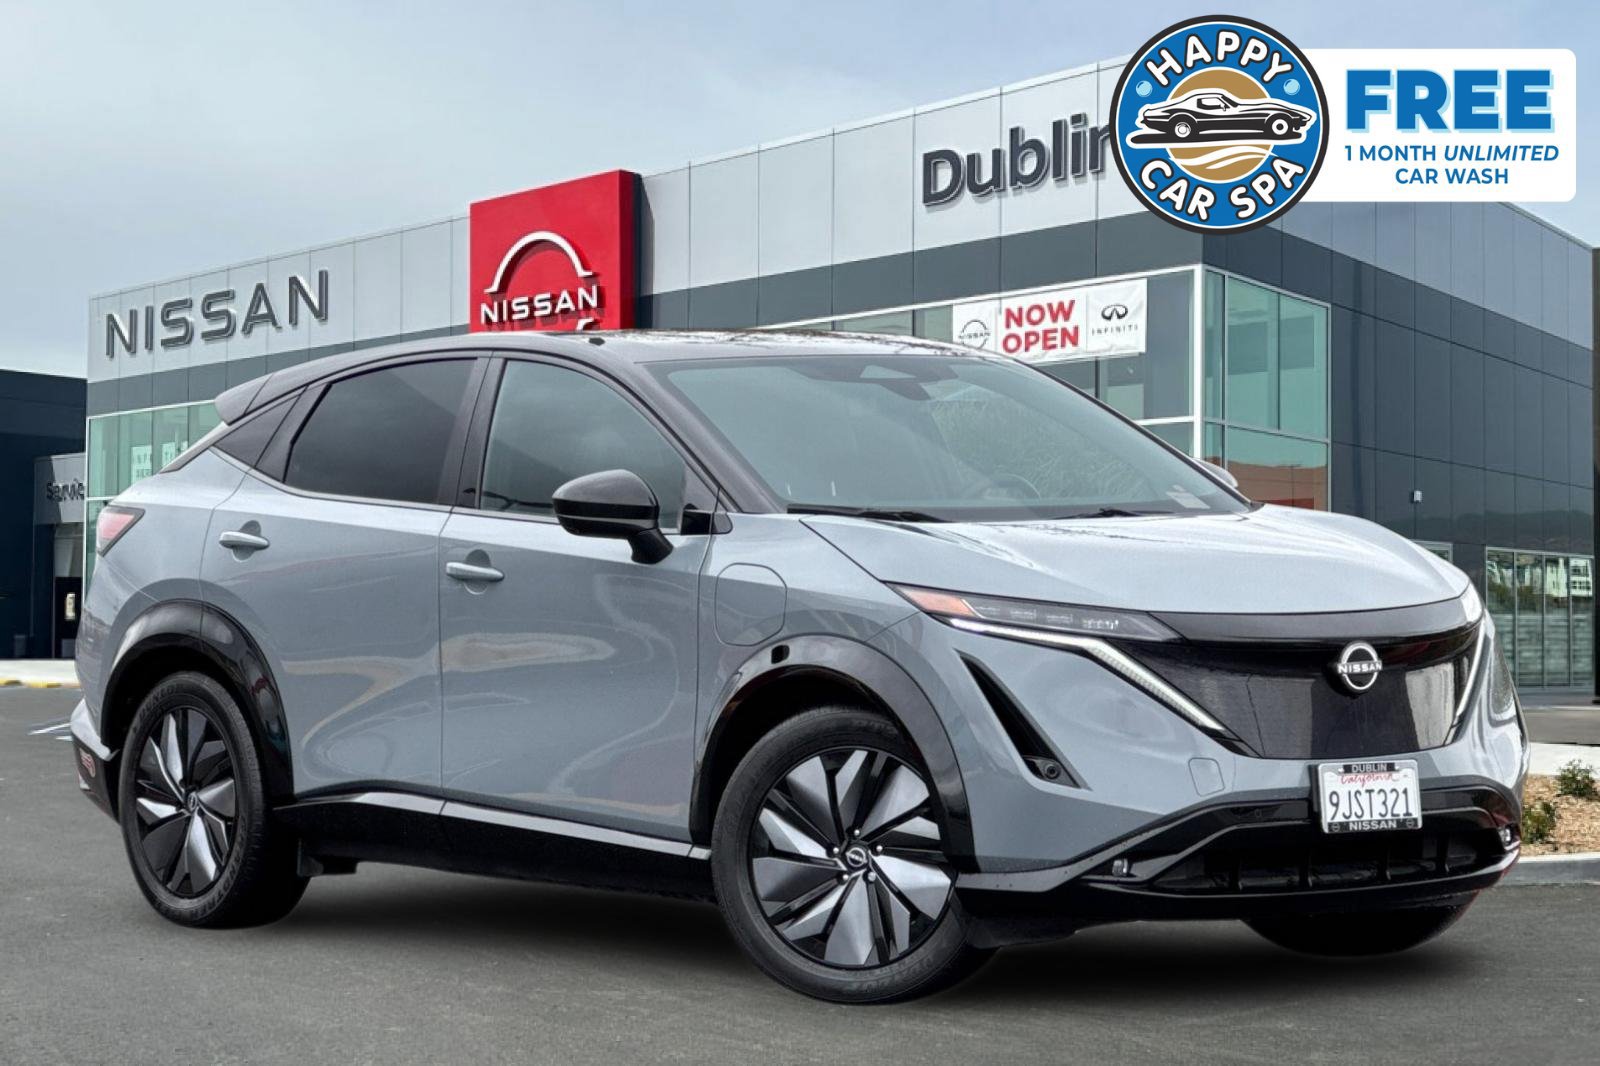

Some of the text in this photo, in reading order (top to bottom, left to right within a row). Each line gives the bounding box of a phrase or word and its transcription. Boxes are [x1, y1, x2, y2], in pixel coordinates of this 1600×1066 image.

[105, 269, 329, 358] NISSAN
[480, 285, 598, 325] NISSAN
[1005, 299, 1076, 330] NOW
[1002, 325, 1079, 353] OPEN
[1091, 324, 1138, 336] INFINITI
[1337, 661, 1382, 674] NISSAN
[1351, 763, 1388, 773] DUBLIN
[1341, 772, 1393, 788] California
[1329, 787, 1412, 821] 9JST321
[1349, 819, 1397, 831] NISSAN
